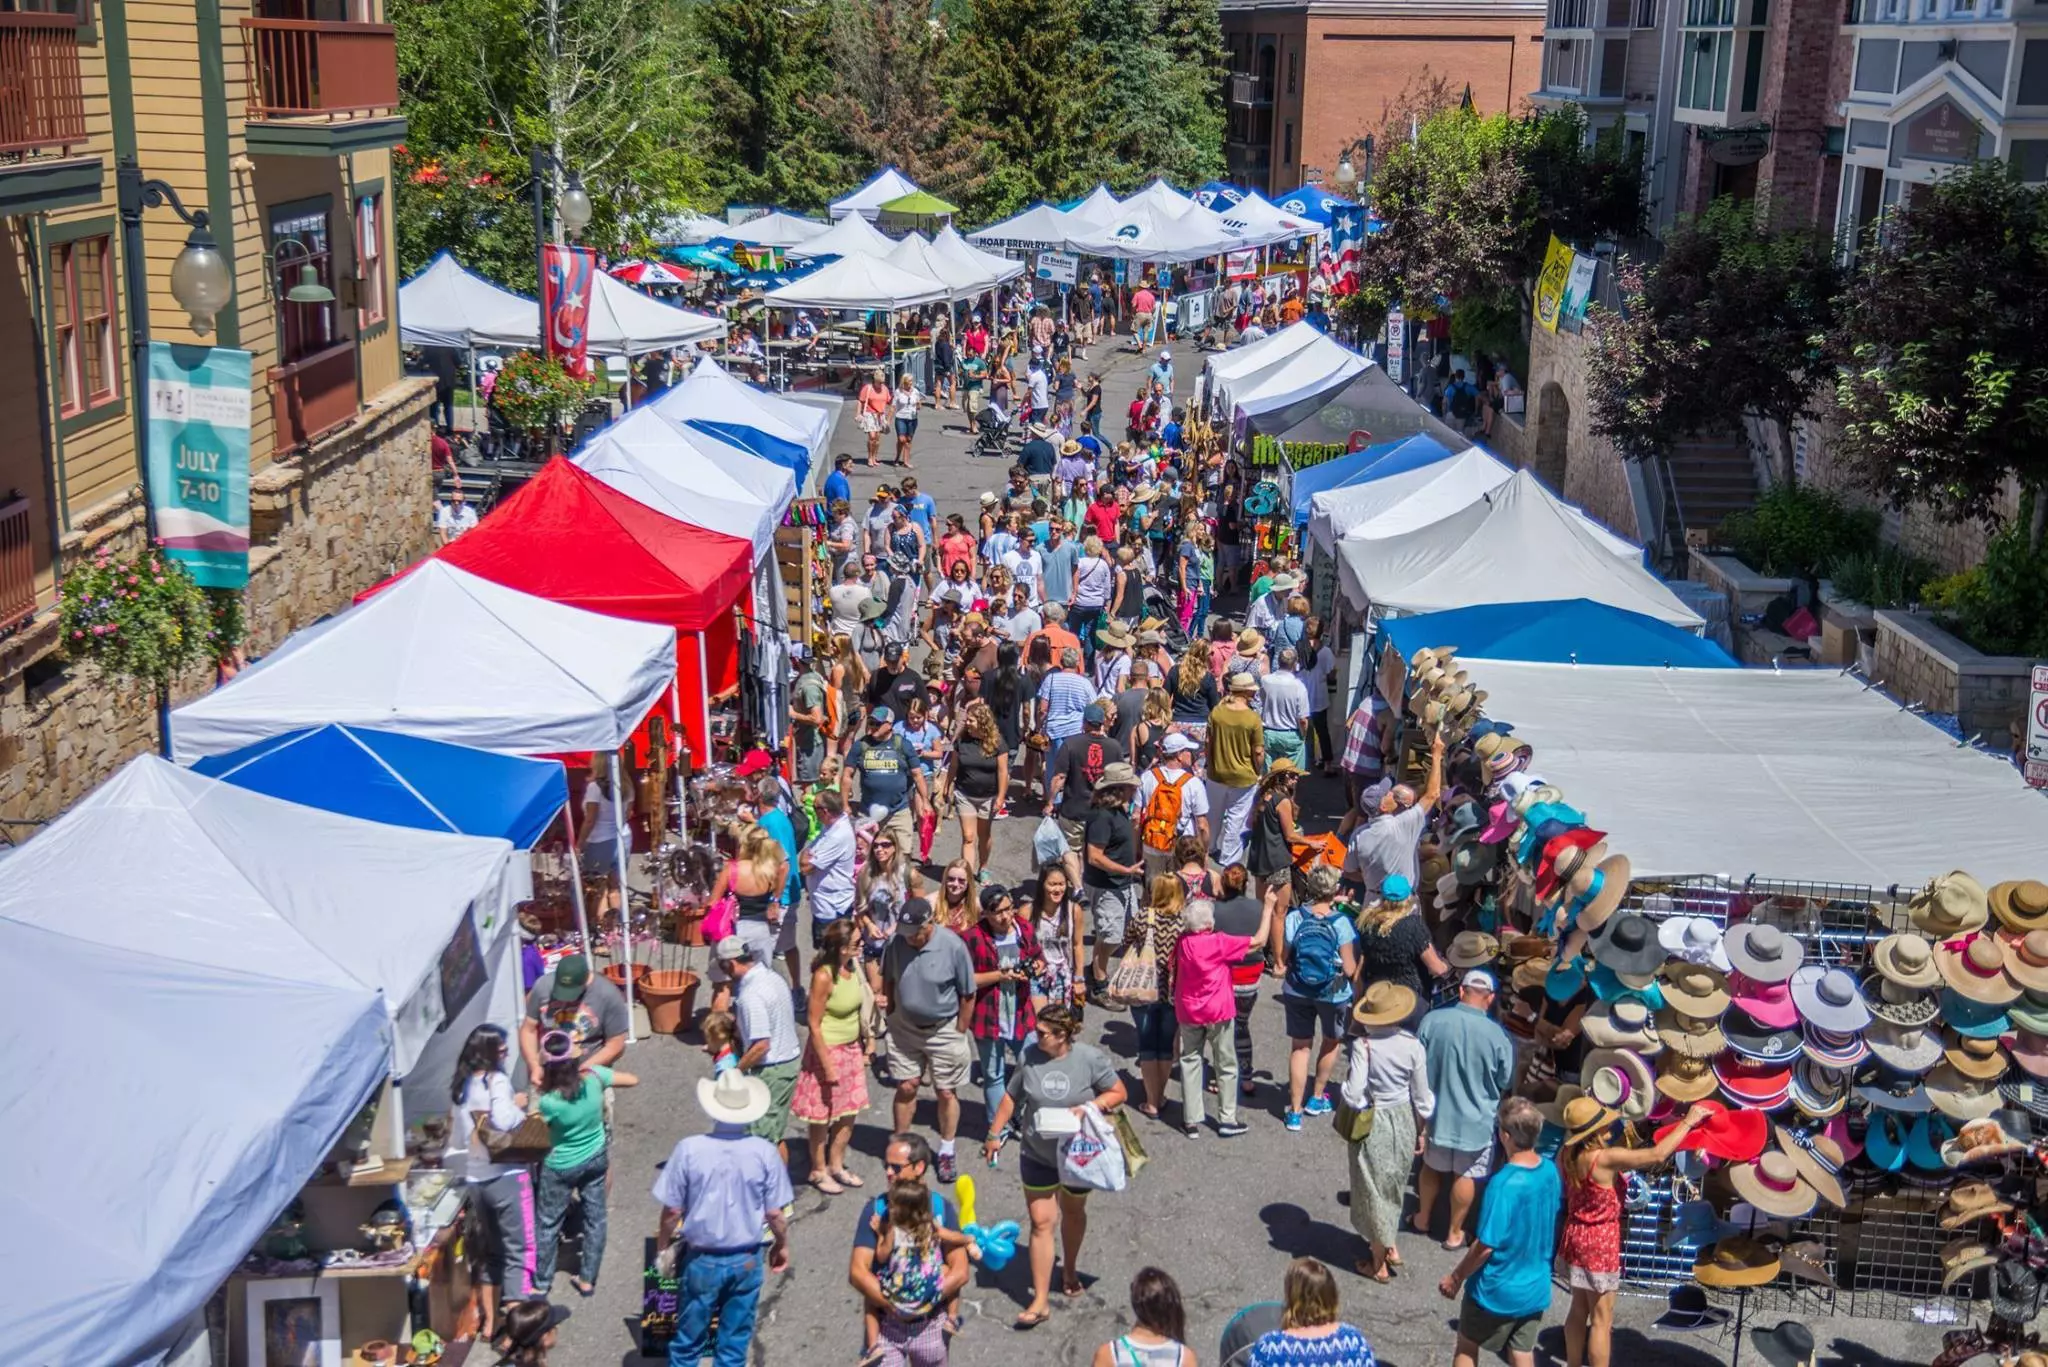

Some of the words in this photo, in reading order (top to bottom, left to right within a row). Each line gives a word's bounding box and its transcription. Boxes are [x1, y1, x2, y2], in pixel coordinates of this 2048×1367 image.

[979, 238, 1005, 247] MOAB
[1007, 239, 1047, 249] BREWERY
[176, 444, 220, 473] JULY
[178, 480, 220, 503] 7-10
